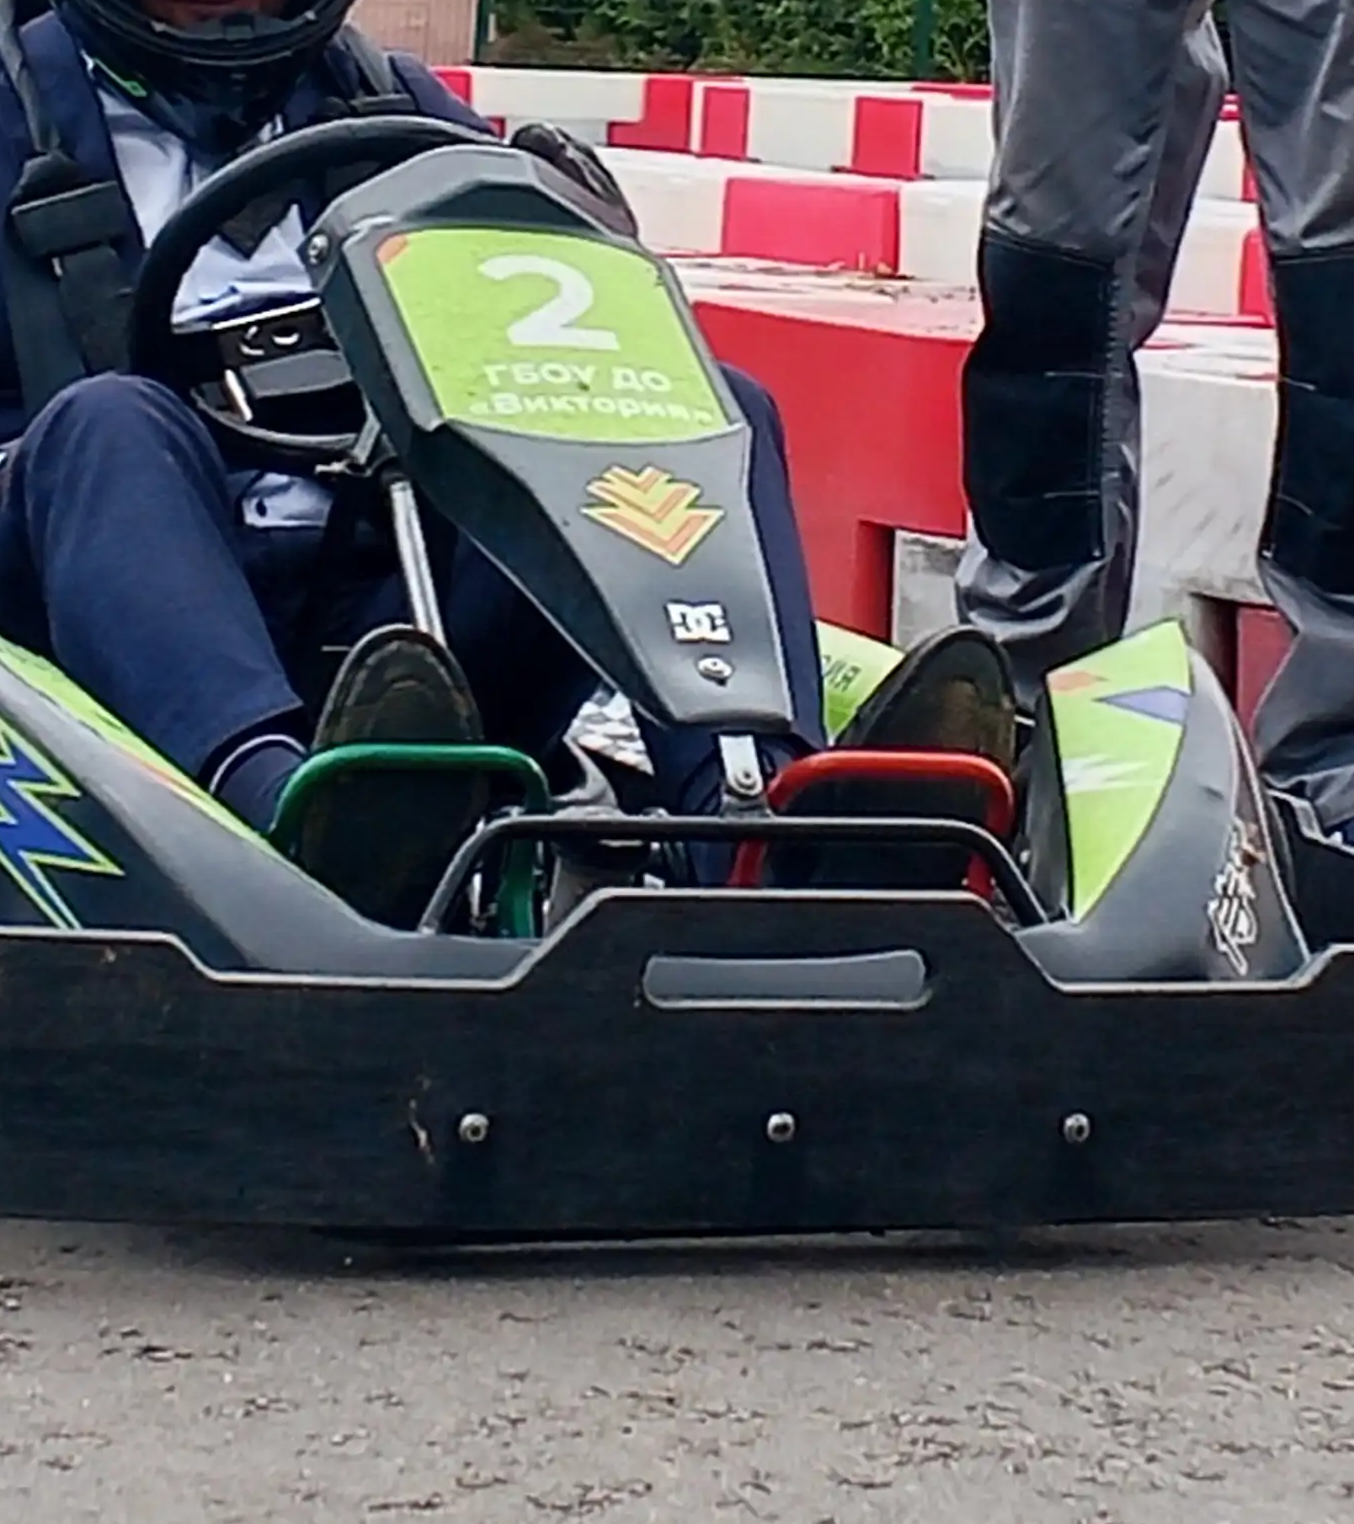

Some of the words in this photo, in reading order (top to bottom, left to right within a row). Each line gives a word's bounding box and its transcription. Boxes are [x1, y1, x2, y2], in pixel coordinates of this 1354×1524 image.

[477, 253, 621, 352] 2
[482, 362, 597, 387] ГБОУ
[610, 366, 673, 392] ДО
